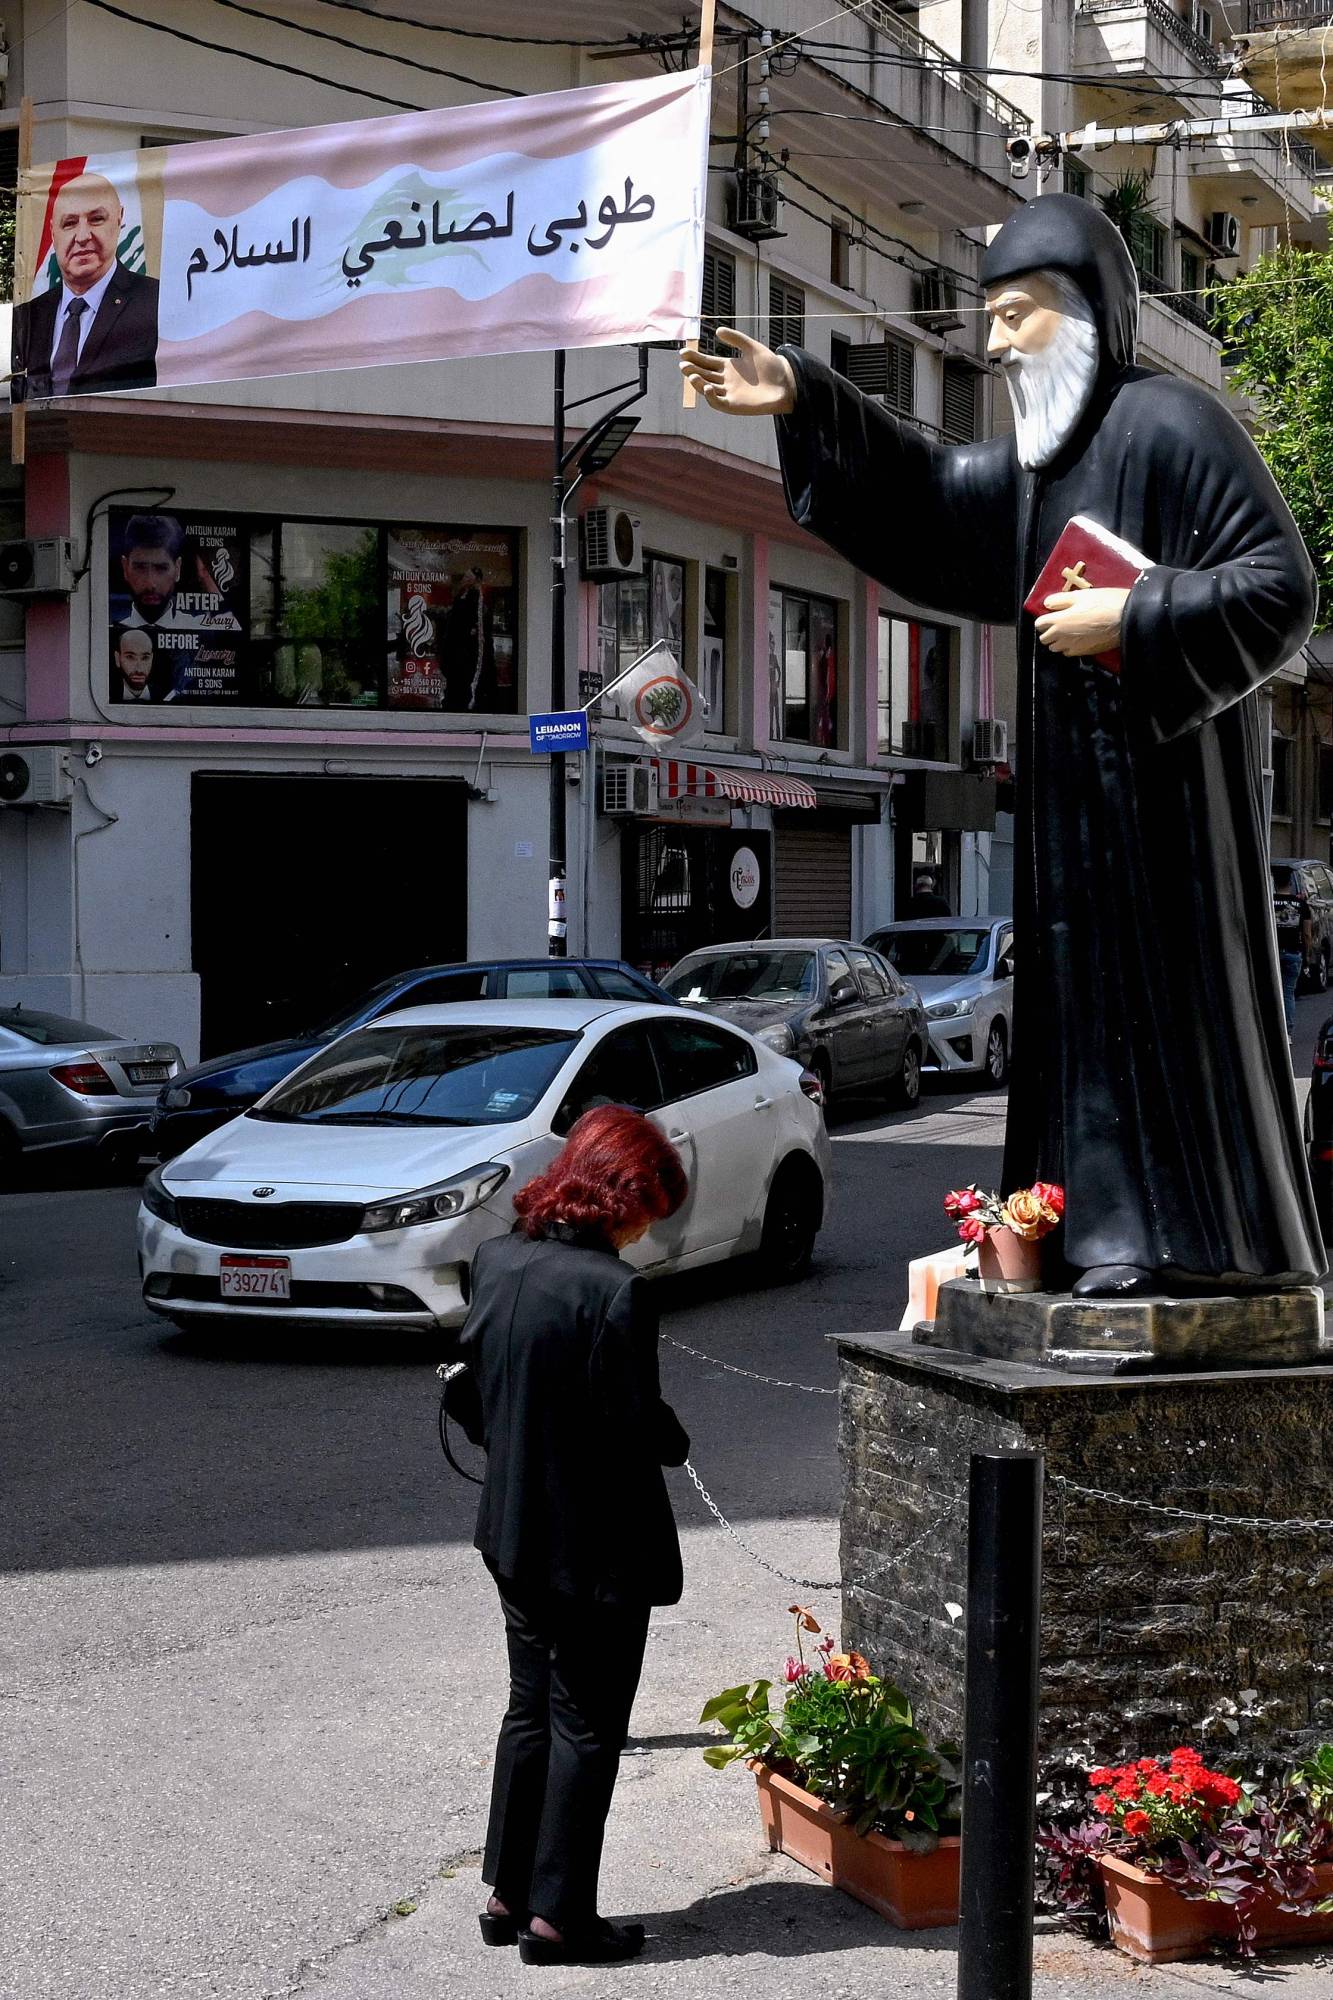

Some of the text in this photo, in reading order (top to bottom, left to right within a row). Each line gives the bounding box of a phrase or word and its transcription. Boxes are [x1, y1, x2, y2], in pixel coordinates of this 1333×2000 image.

[187, 176, 655, 301] طوبى لصانعي السلام
[185, 525, 237, 537] ANTOUN KARAM
[206, 538, 224, 547] SONS
[391, 571, 445, 583] ANTOUN KARAM
[413, 584, 432, 593] SONS
[176, 592, 219, 611] AFTER
[158, 633, 200, 650] BEFORE
[184, 667, 235, 678] ANTOUN KARAM
[204, 679, 223, 689] SONS
[535, 723, 581, 735] LEBANON
[545, 732, 582, 740] TOMORROW
